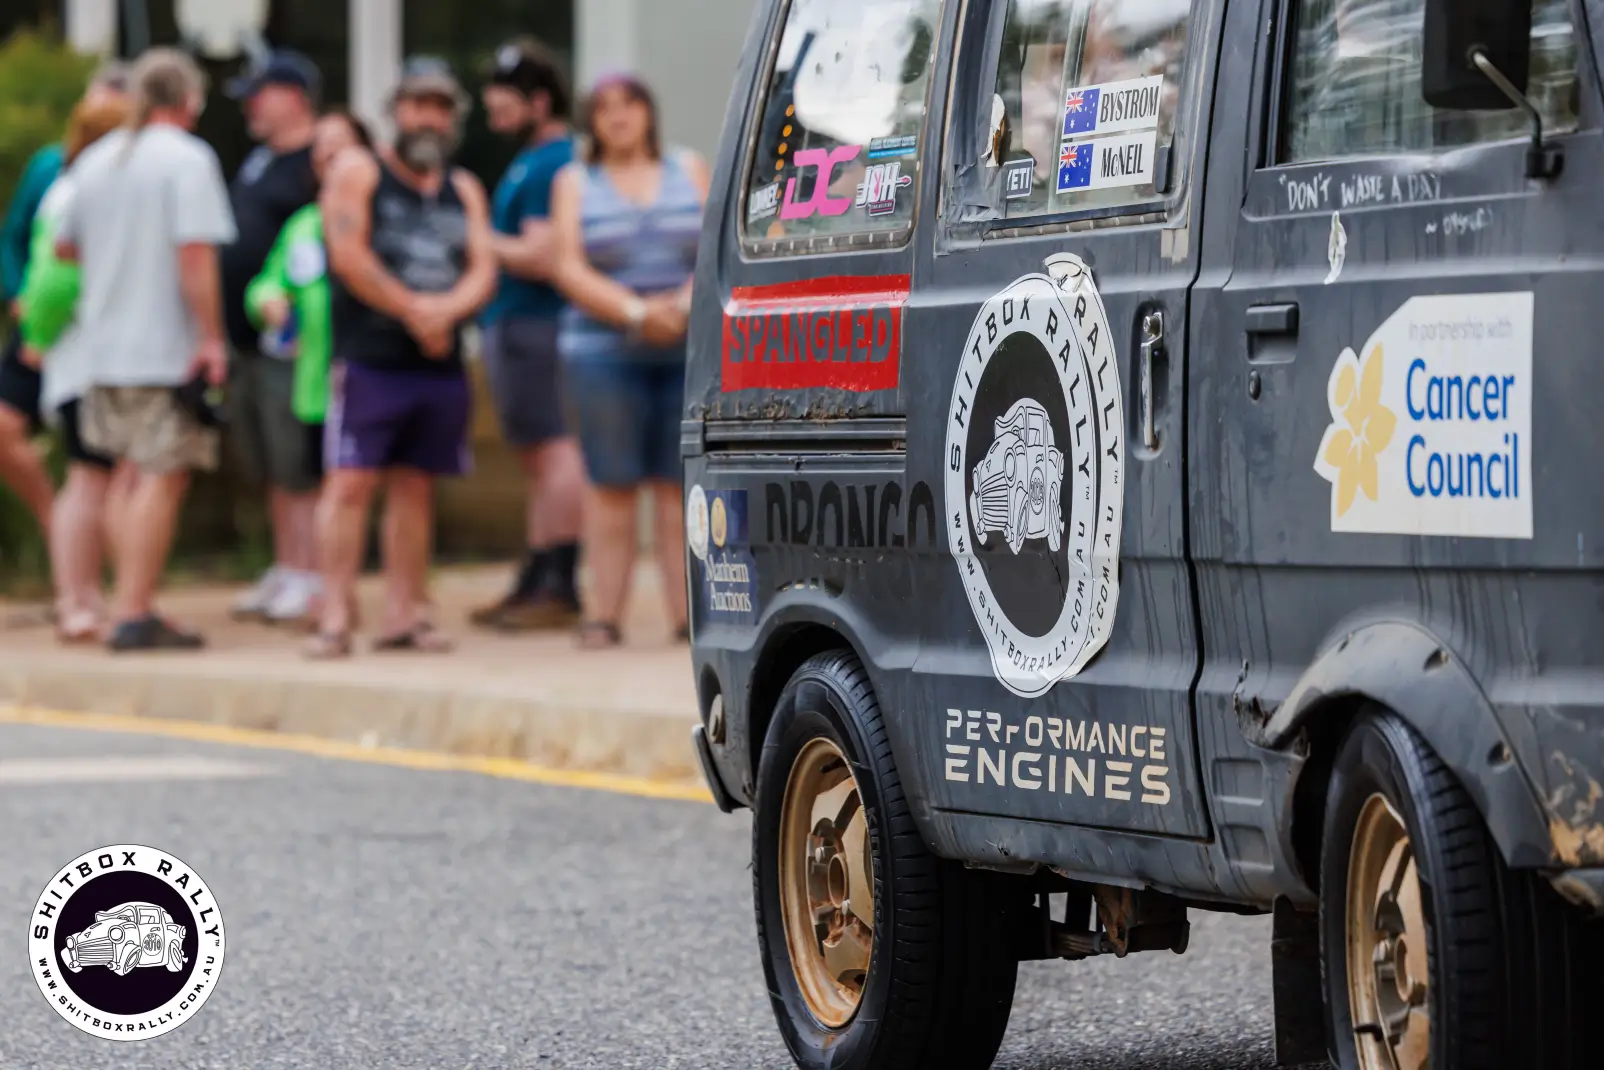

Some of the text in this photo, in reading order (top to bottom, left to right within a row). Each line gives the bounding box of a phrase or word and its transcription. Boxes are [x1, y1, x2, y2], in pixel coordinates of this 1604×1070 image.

[1100, 86, 1160, 123] BYSTROM
[728, 305, 894, 364] SPANGLED
[950, 293, 1035, 473] SHITBOX
[1045, 308, 1091, 478] RALLY
[1074, 293, 1119, 462] RALLY
[1406, 358, 1515, 421] Cancer
[1406, 432, 1519, 499] Council
[945, 744, 1171, 805] ENGINES
